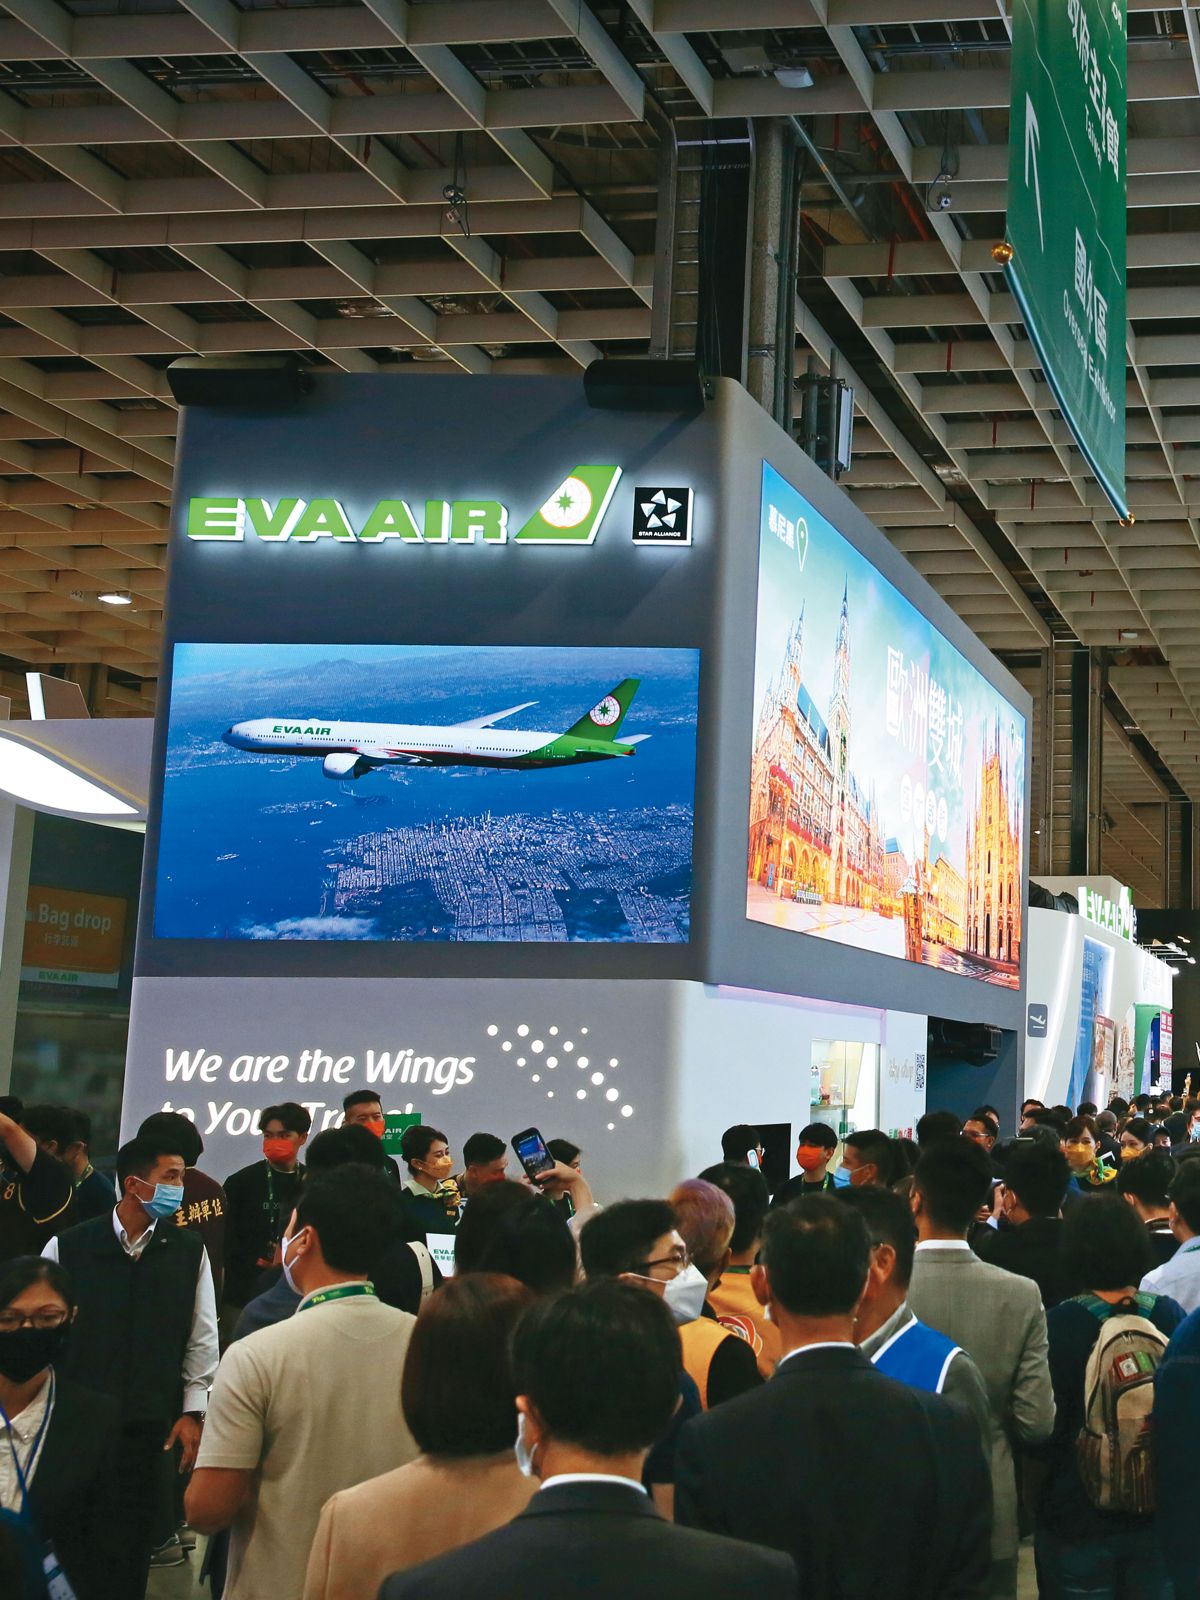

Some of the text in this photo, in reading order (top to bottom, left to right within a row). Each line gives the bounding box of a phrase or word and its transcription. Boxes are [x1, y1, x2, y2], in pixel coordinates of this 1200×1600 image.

[1088, 353, 1116, 425] Exhibitor
[886, 645, 963, 787] 歐洲雙城
[38, 903, 111, 934] Bag drop
[165, 1049, 476, 1095] We are the Wings
